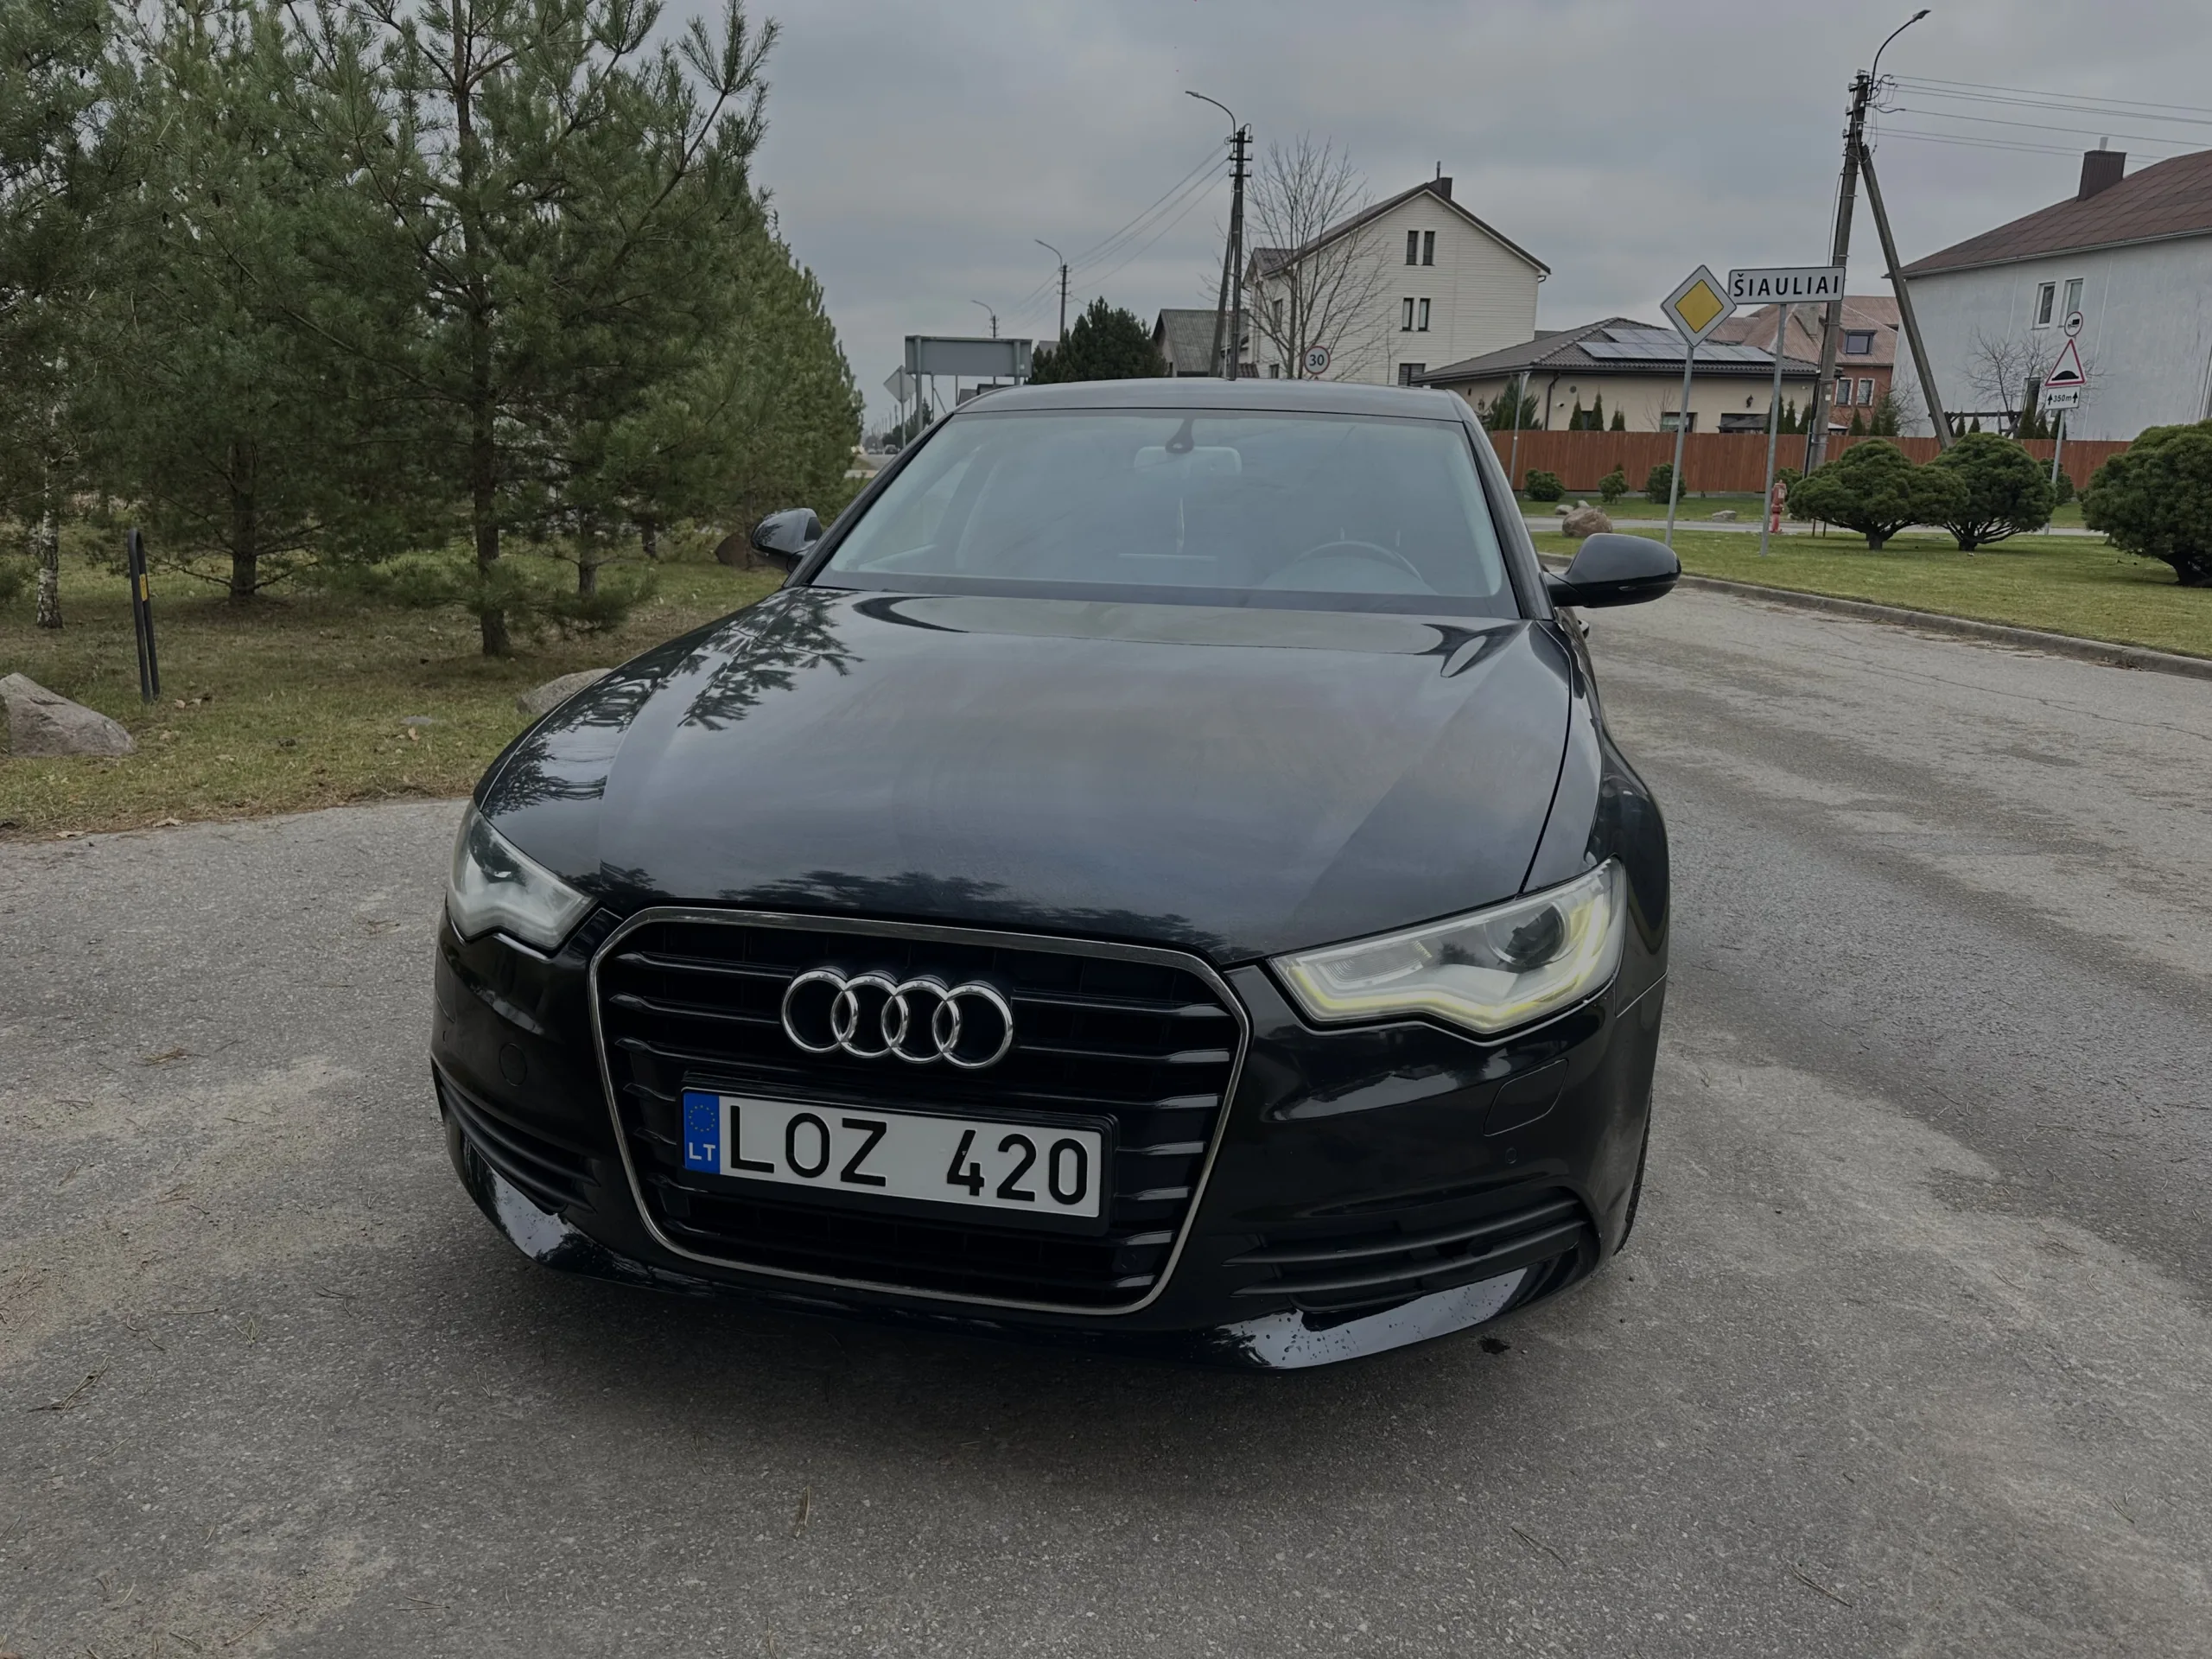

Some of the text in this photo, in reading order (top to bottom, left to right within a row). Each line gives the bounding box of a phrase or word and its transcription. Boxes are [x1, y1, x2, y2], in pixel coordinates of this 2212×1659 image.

[1733, 273, 1839, 296] ŠIAULIAI
[1309, 354, 1325, 366] 30
[689, 1141, 716, 1162] LT
[730, 1105, 1088, 1205] LOZ 420
